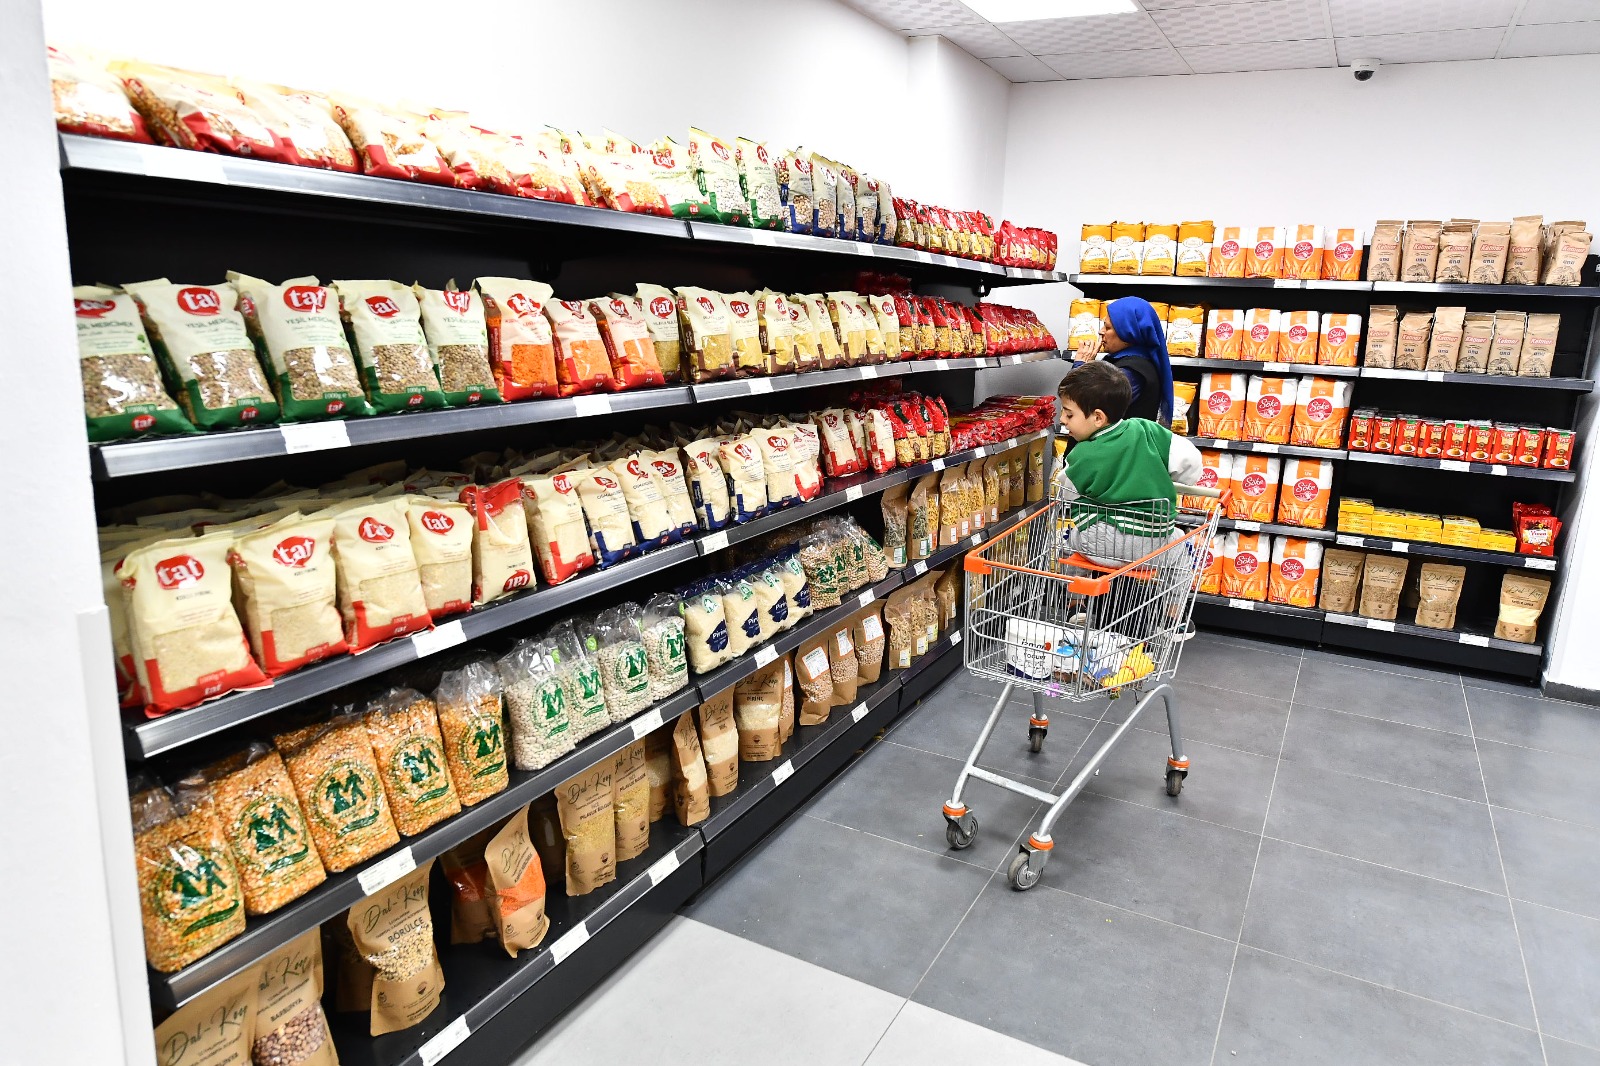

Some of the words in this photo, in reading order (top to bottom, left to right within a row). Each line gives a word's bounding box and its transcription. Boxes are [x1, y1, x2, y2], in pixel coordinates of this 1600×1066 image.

[290, 287, 326, 307] tat
[368, 299, 400, 314] tat
[651, 300, 673, 316] tat
[1328, 330, 1345, 340] Söke
[409, 396, 423, 405] tat
[469, 394, 481, 402] tat
[1210, 394, 1229, 405] Söke
[1259, 397, 1280, 409] Söke
[327, 403, 344, 412] tat
[1308, 402, 1330, 412] Söke
[1245, 476, 1265, 487] Söke
[1296, 482, 1316, 493] Söke
[423, 514, 452, 531] tat
[275, 540, 314, 564] tat
[1237, 555, 1255, 566] Söke
[157, 558, 202, 586] tat
[1282, 561, 1302, 572] Söke
[506, 574, 530, 591] tat
[363, 882, 425, 934] Dal-Koop
[387, 916, 425, 944] BÖRÜLCE
